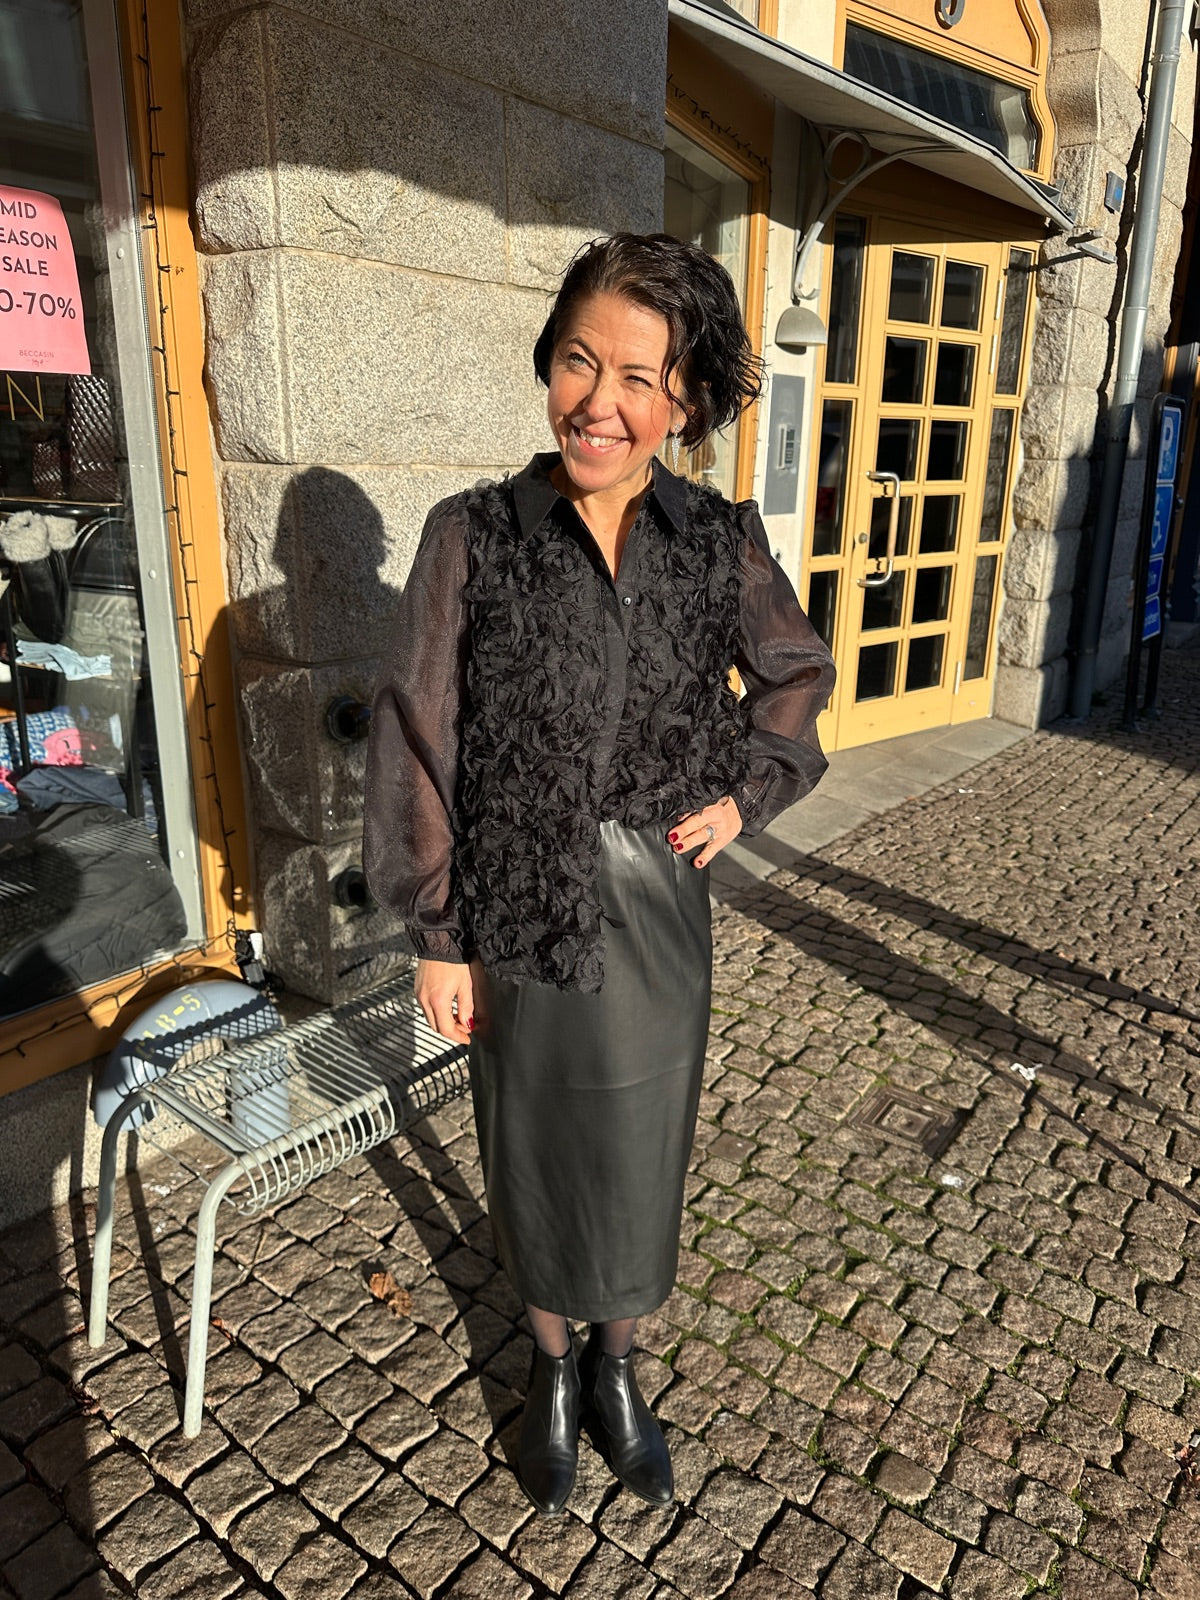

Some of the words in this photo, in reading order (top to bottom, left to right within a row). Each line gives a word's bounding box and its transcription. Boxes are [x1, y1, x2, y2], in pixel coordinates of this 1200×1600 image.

[0, 198, 37, 219] MID
[0, 227, 57, 250] EASON
[3, 256, 49, 276] SALE
[0, 288, 76, 319] 0-70%
[19, 349, 55, 358] BECCASIN
[1157, 416, 1174, 475] P
